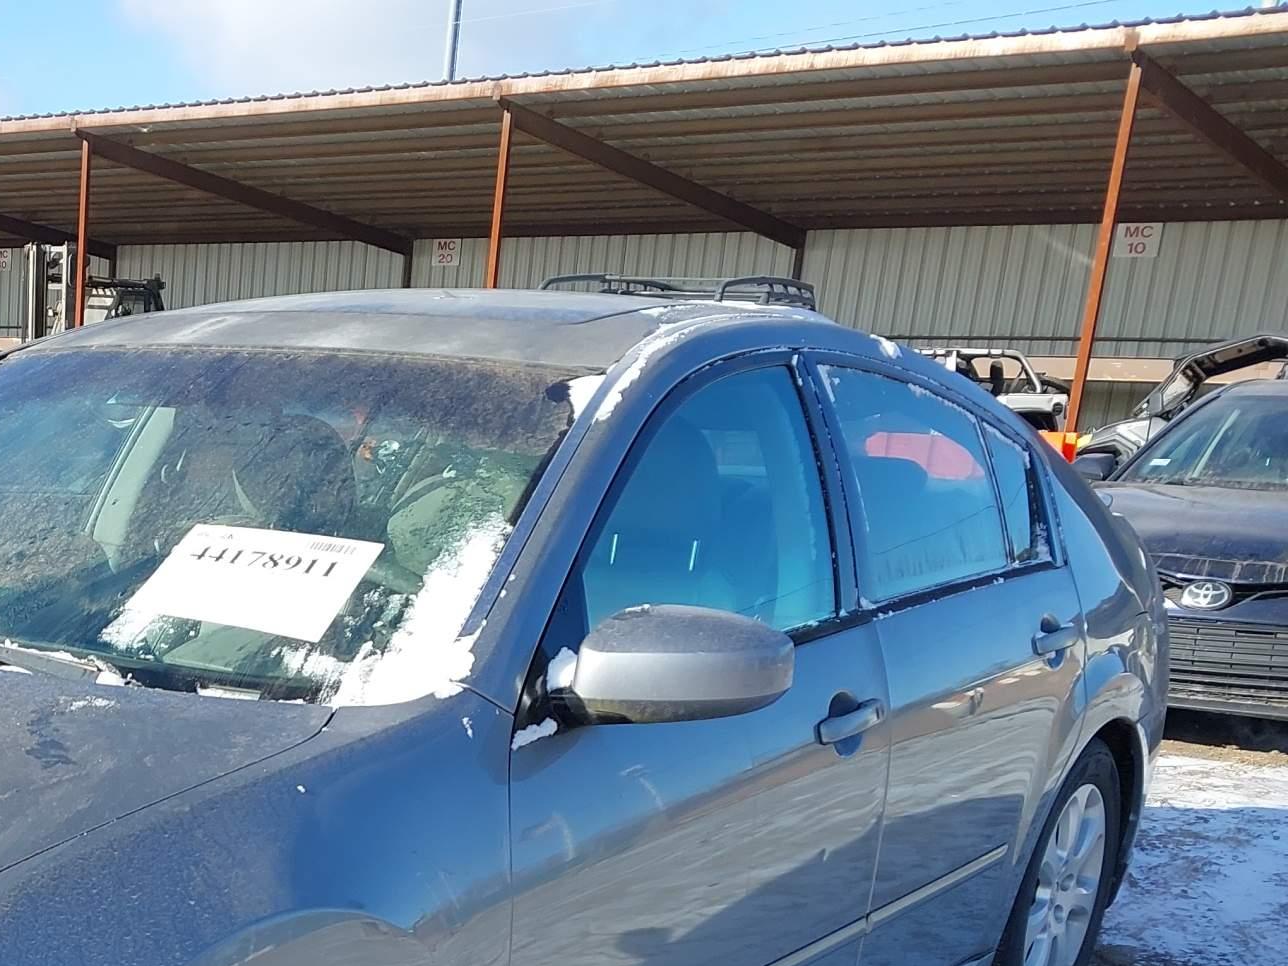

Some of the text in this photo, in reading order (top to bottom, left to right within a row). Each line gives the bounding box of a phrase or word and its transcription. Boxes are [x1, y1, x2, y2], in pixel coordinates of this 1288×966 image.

[1124, 225, 1154, 238] MC
[437, 240, 456, 251] MC
[1127, 241, 1146, 255] 10
[438, 253, 453, 264] 20
[190, 545, 339, 577] 44178911
